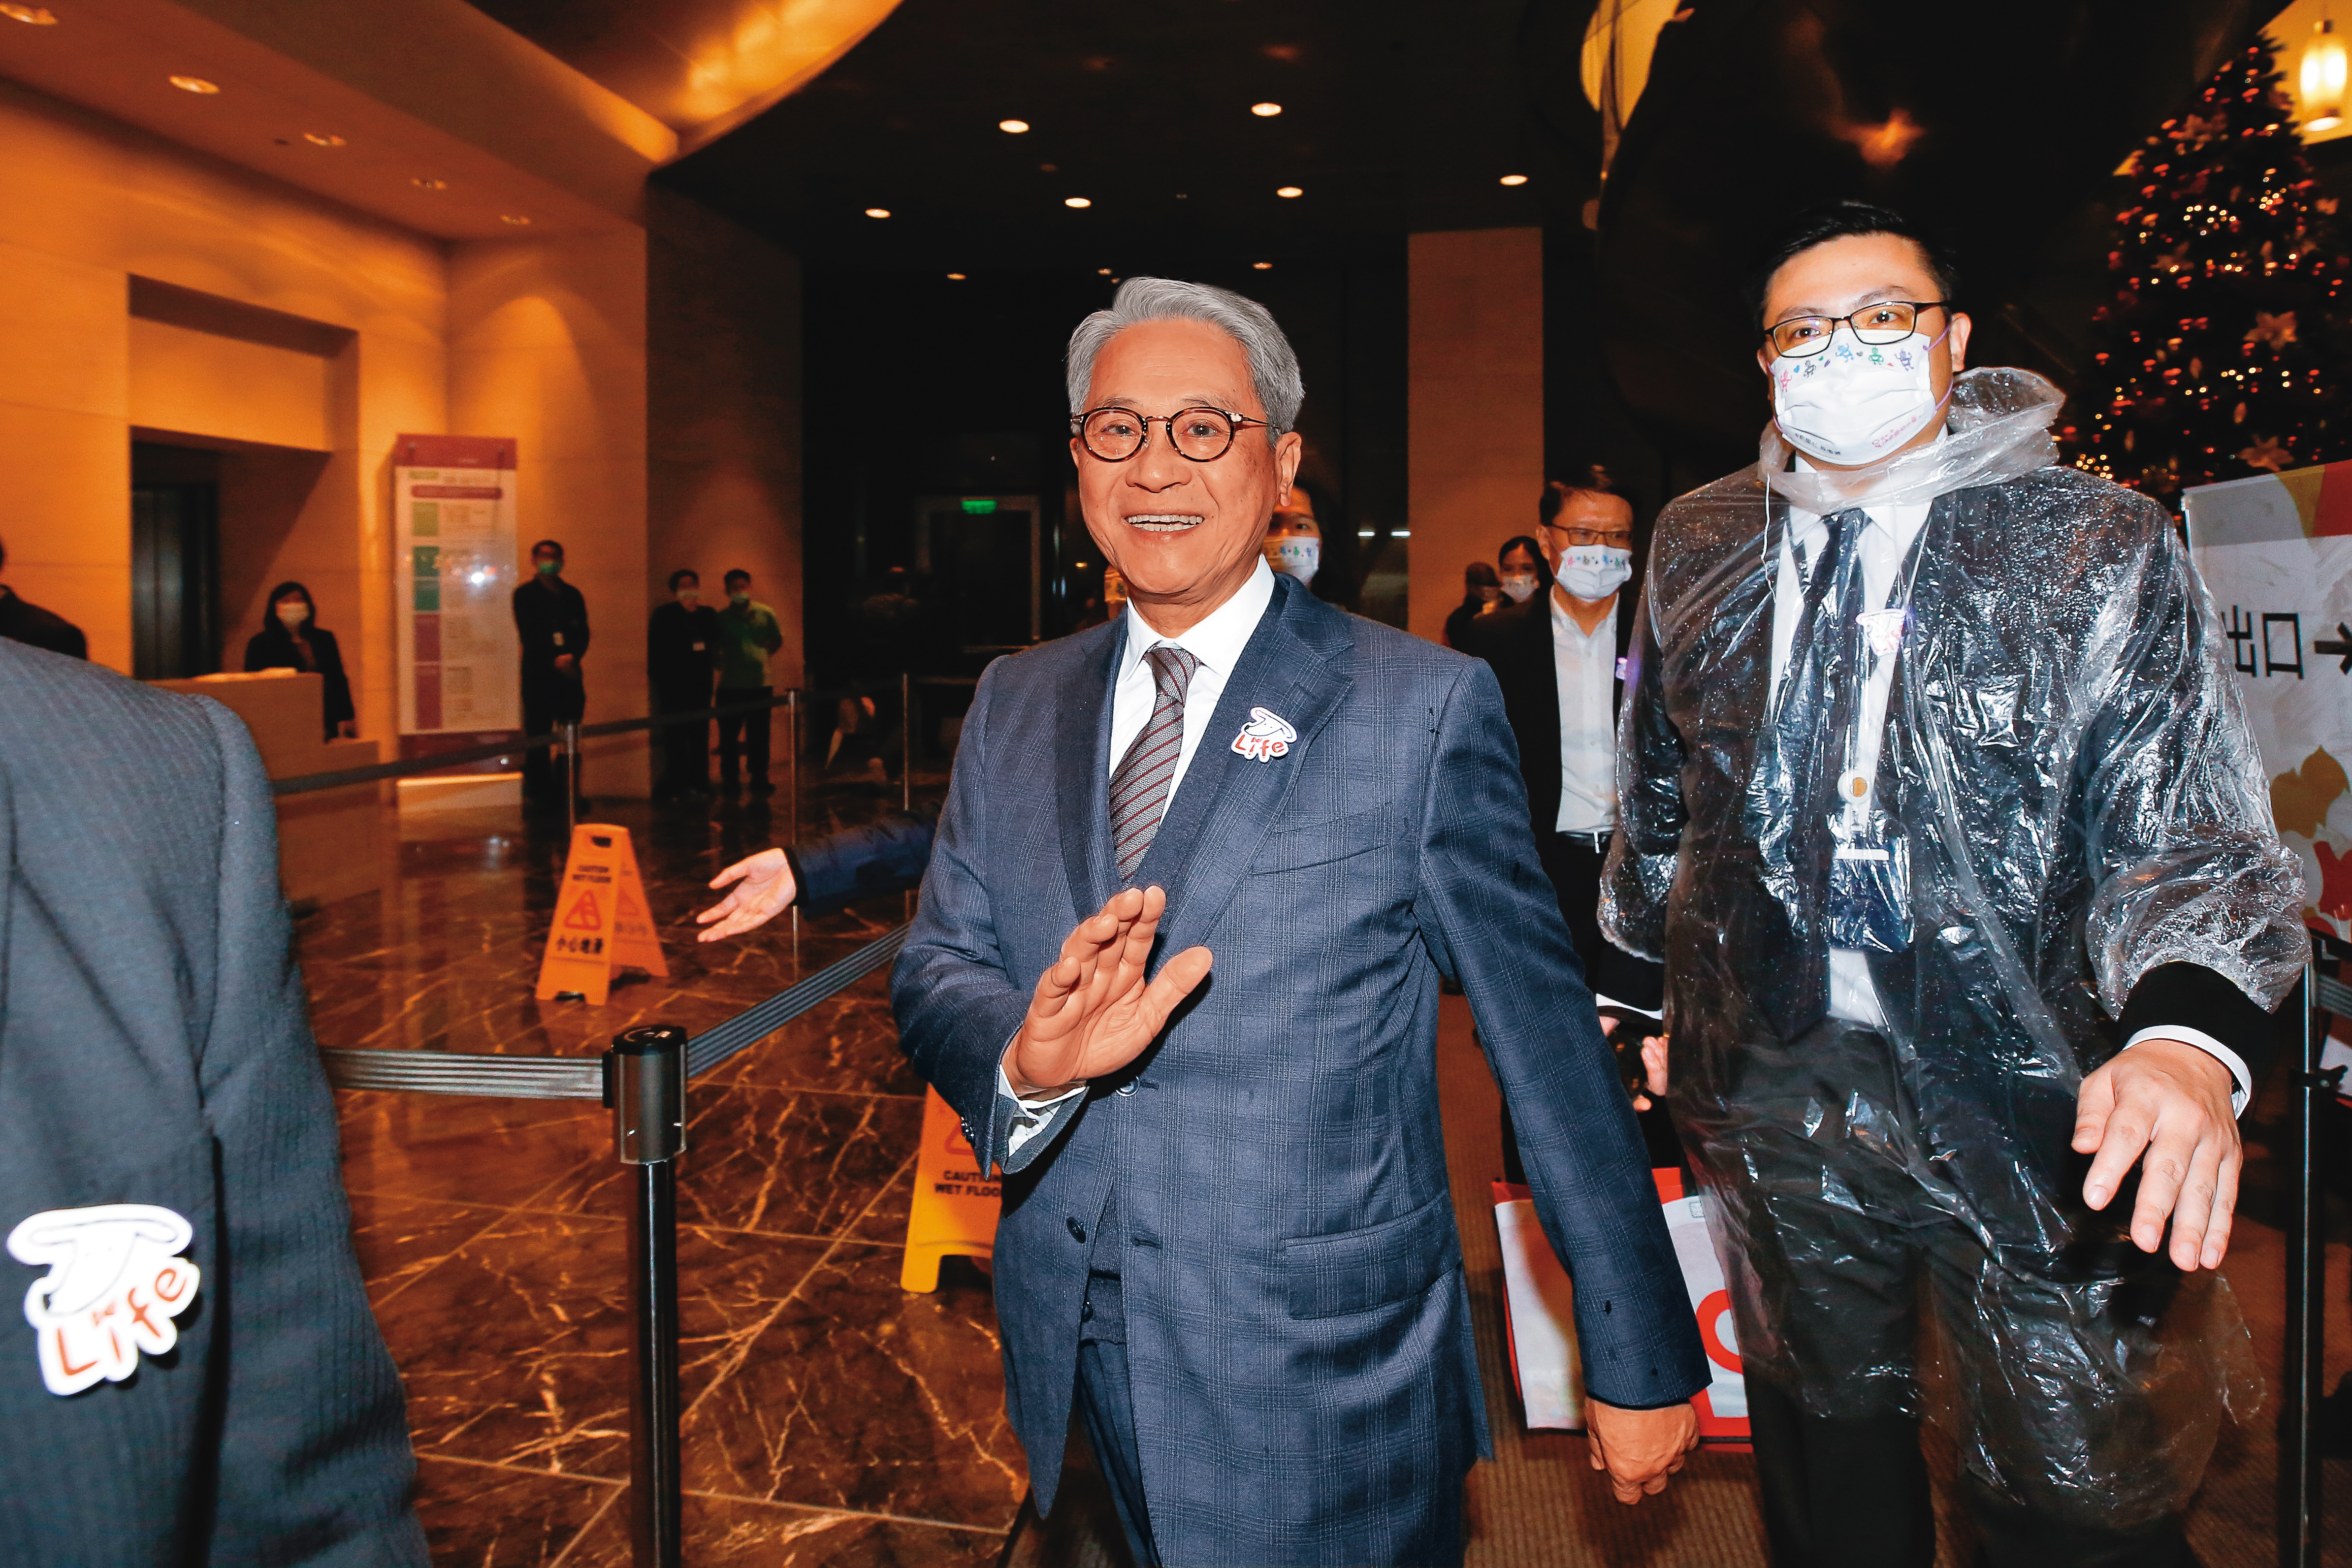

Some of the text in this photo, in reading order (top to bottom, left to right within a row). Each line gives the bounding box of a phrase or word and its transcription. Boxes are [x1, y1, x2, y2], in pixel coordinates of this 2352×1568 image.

[2221, 605, 2305, 679] 出口
[1235, 734, 1285, 759] Life
[934, 1183, 1001, 1197] WET FLOO
[55, 1267, 188, 1376] Life
